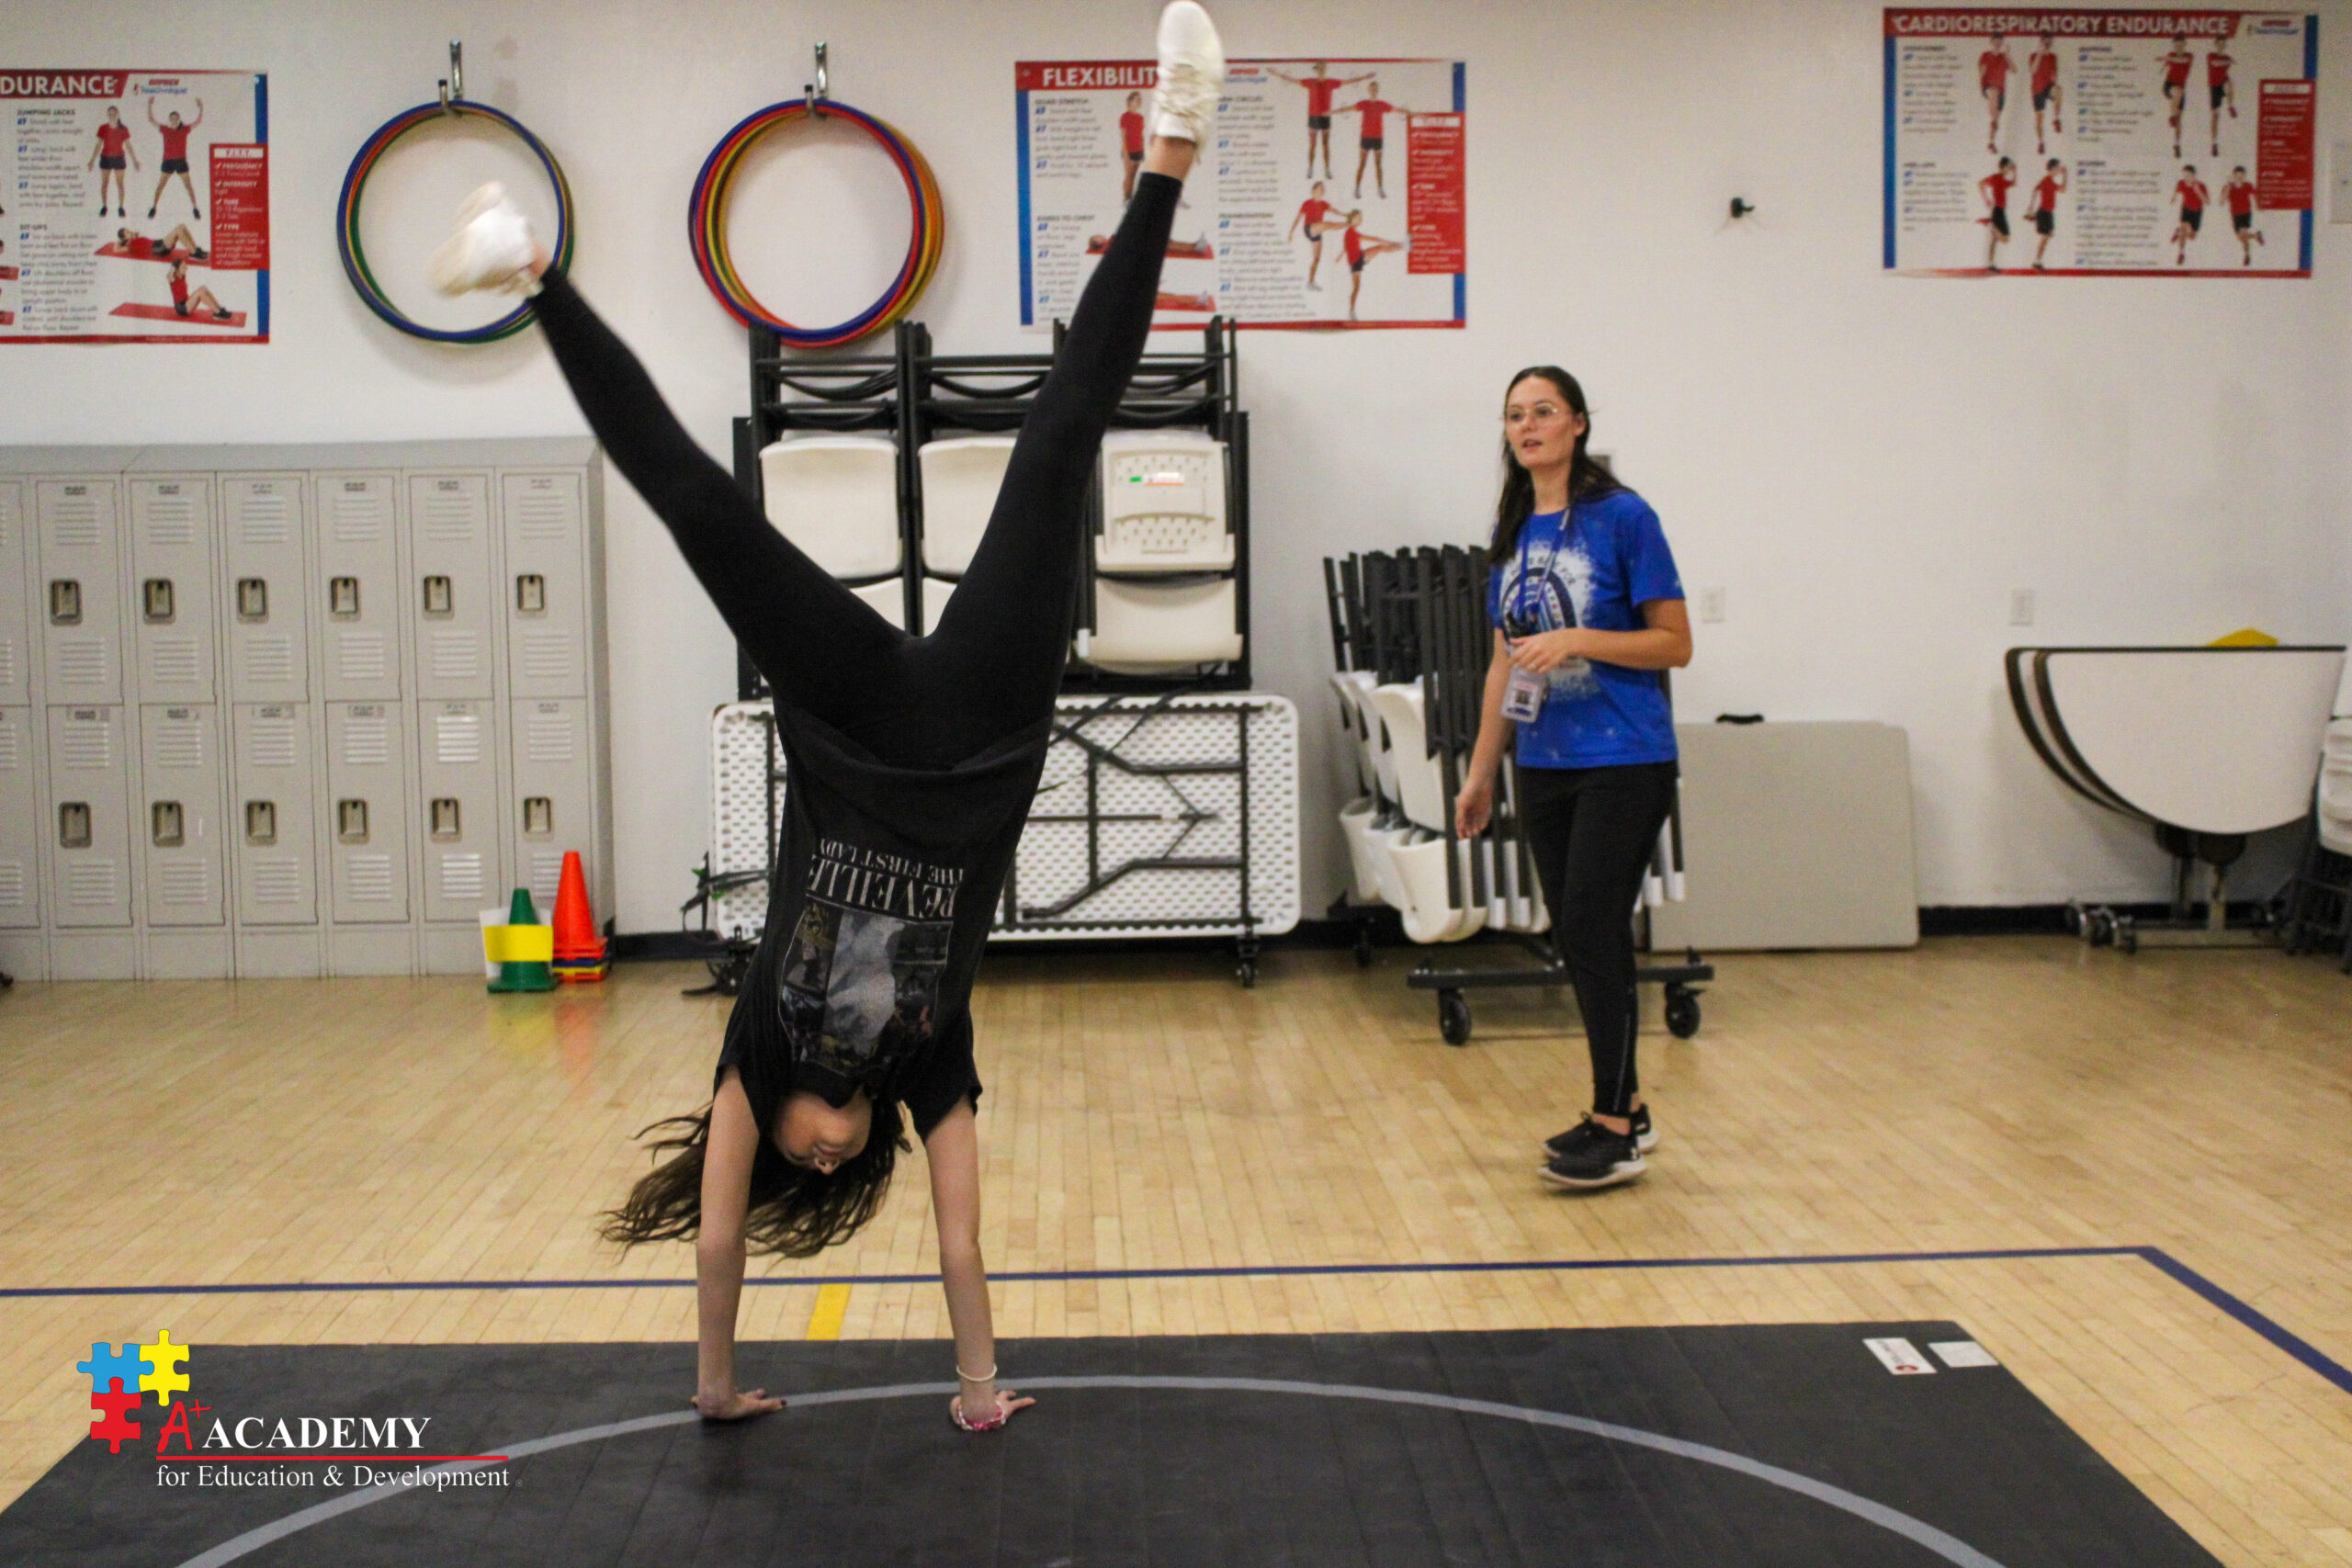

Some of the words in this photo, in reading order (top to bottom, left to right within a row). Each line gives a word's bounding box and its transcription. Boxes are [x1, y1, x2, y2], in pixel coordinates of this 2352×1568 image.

[1894, 16, 2104, 33] CARDIORESPIRATORY
[2107, 17, 2228, 34] ENDURANCE
[1043, 67, 1157, 86] FLEXIBILIT
[820, 838, 858, 863] LADY
[861, 851, 922, 878] FIRST
[929, 864, 964, 885] THE
[808, 854, 958, 918] REVEILLE
